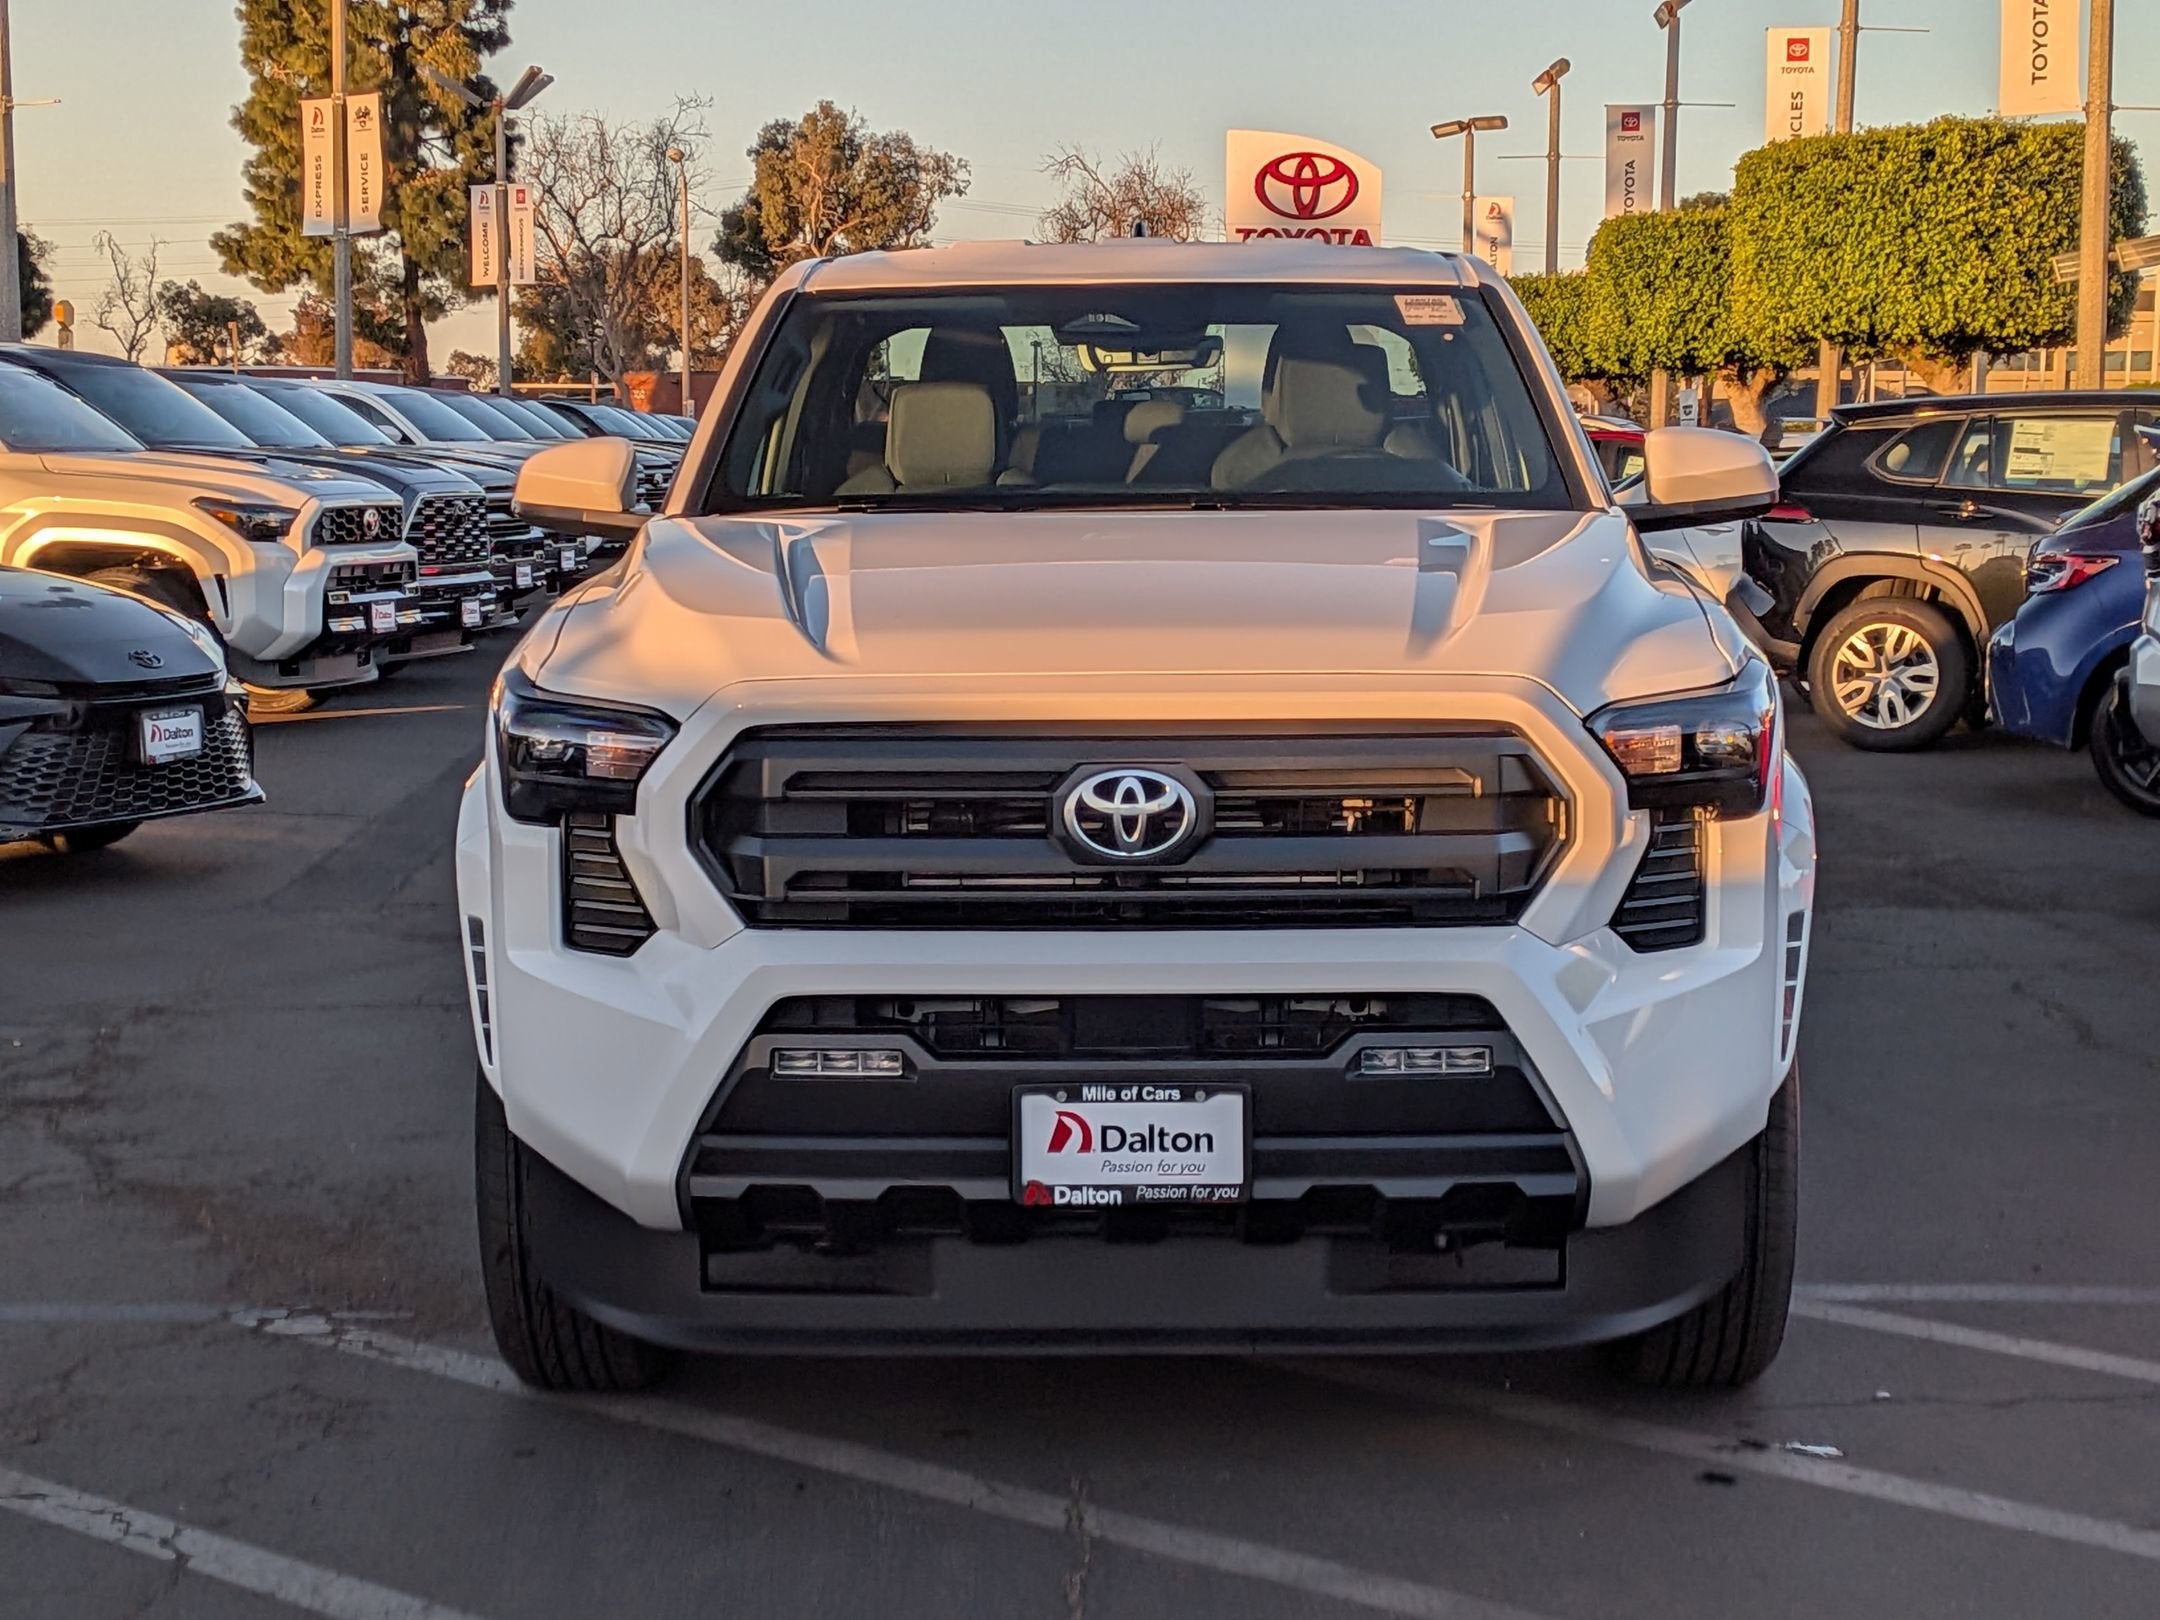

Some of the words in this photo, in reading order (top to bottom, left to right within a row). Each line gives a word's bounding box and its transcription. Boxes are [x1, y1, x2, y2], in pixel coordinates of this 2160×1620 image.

[2031, 0, 2048, 86] TOYOTA
[1781, 66, 1815, 74] TOYOTA
[360, 153, 369, 214] SERVICE
[163, 727, 193, 741] Dalton
[1082, 1086, 1114, 1101] Mile
[1120, 1086, 1138, 1101] of
[1142, 1086, 1181, 1101] Cars
[1100, 1123, 1214, 1153] Dalton
[1101, 1159, 1153, 1173] Passion
[1157, 1159, 1177, 1174] for
[1180, 1162, 1206, 1174] you
[1054, 1186, 1123, 1205] Dalton
[1135, 1185, 1187, 1199] Passion
[1190, 1185, 1211, 1199] for
[1214, 1186, 1240, 1200] you
